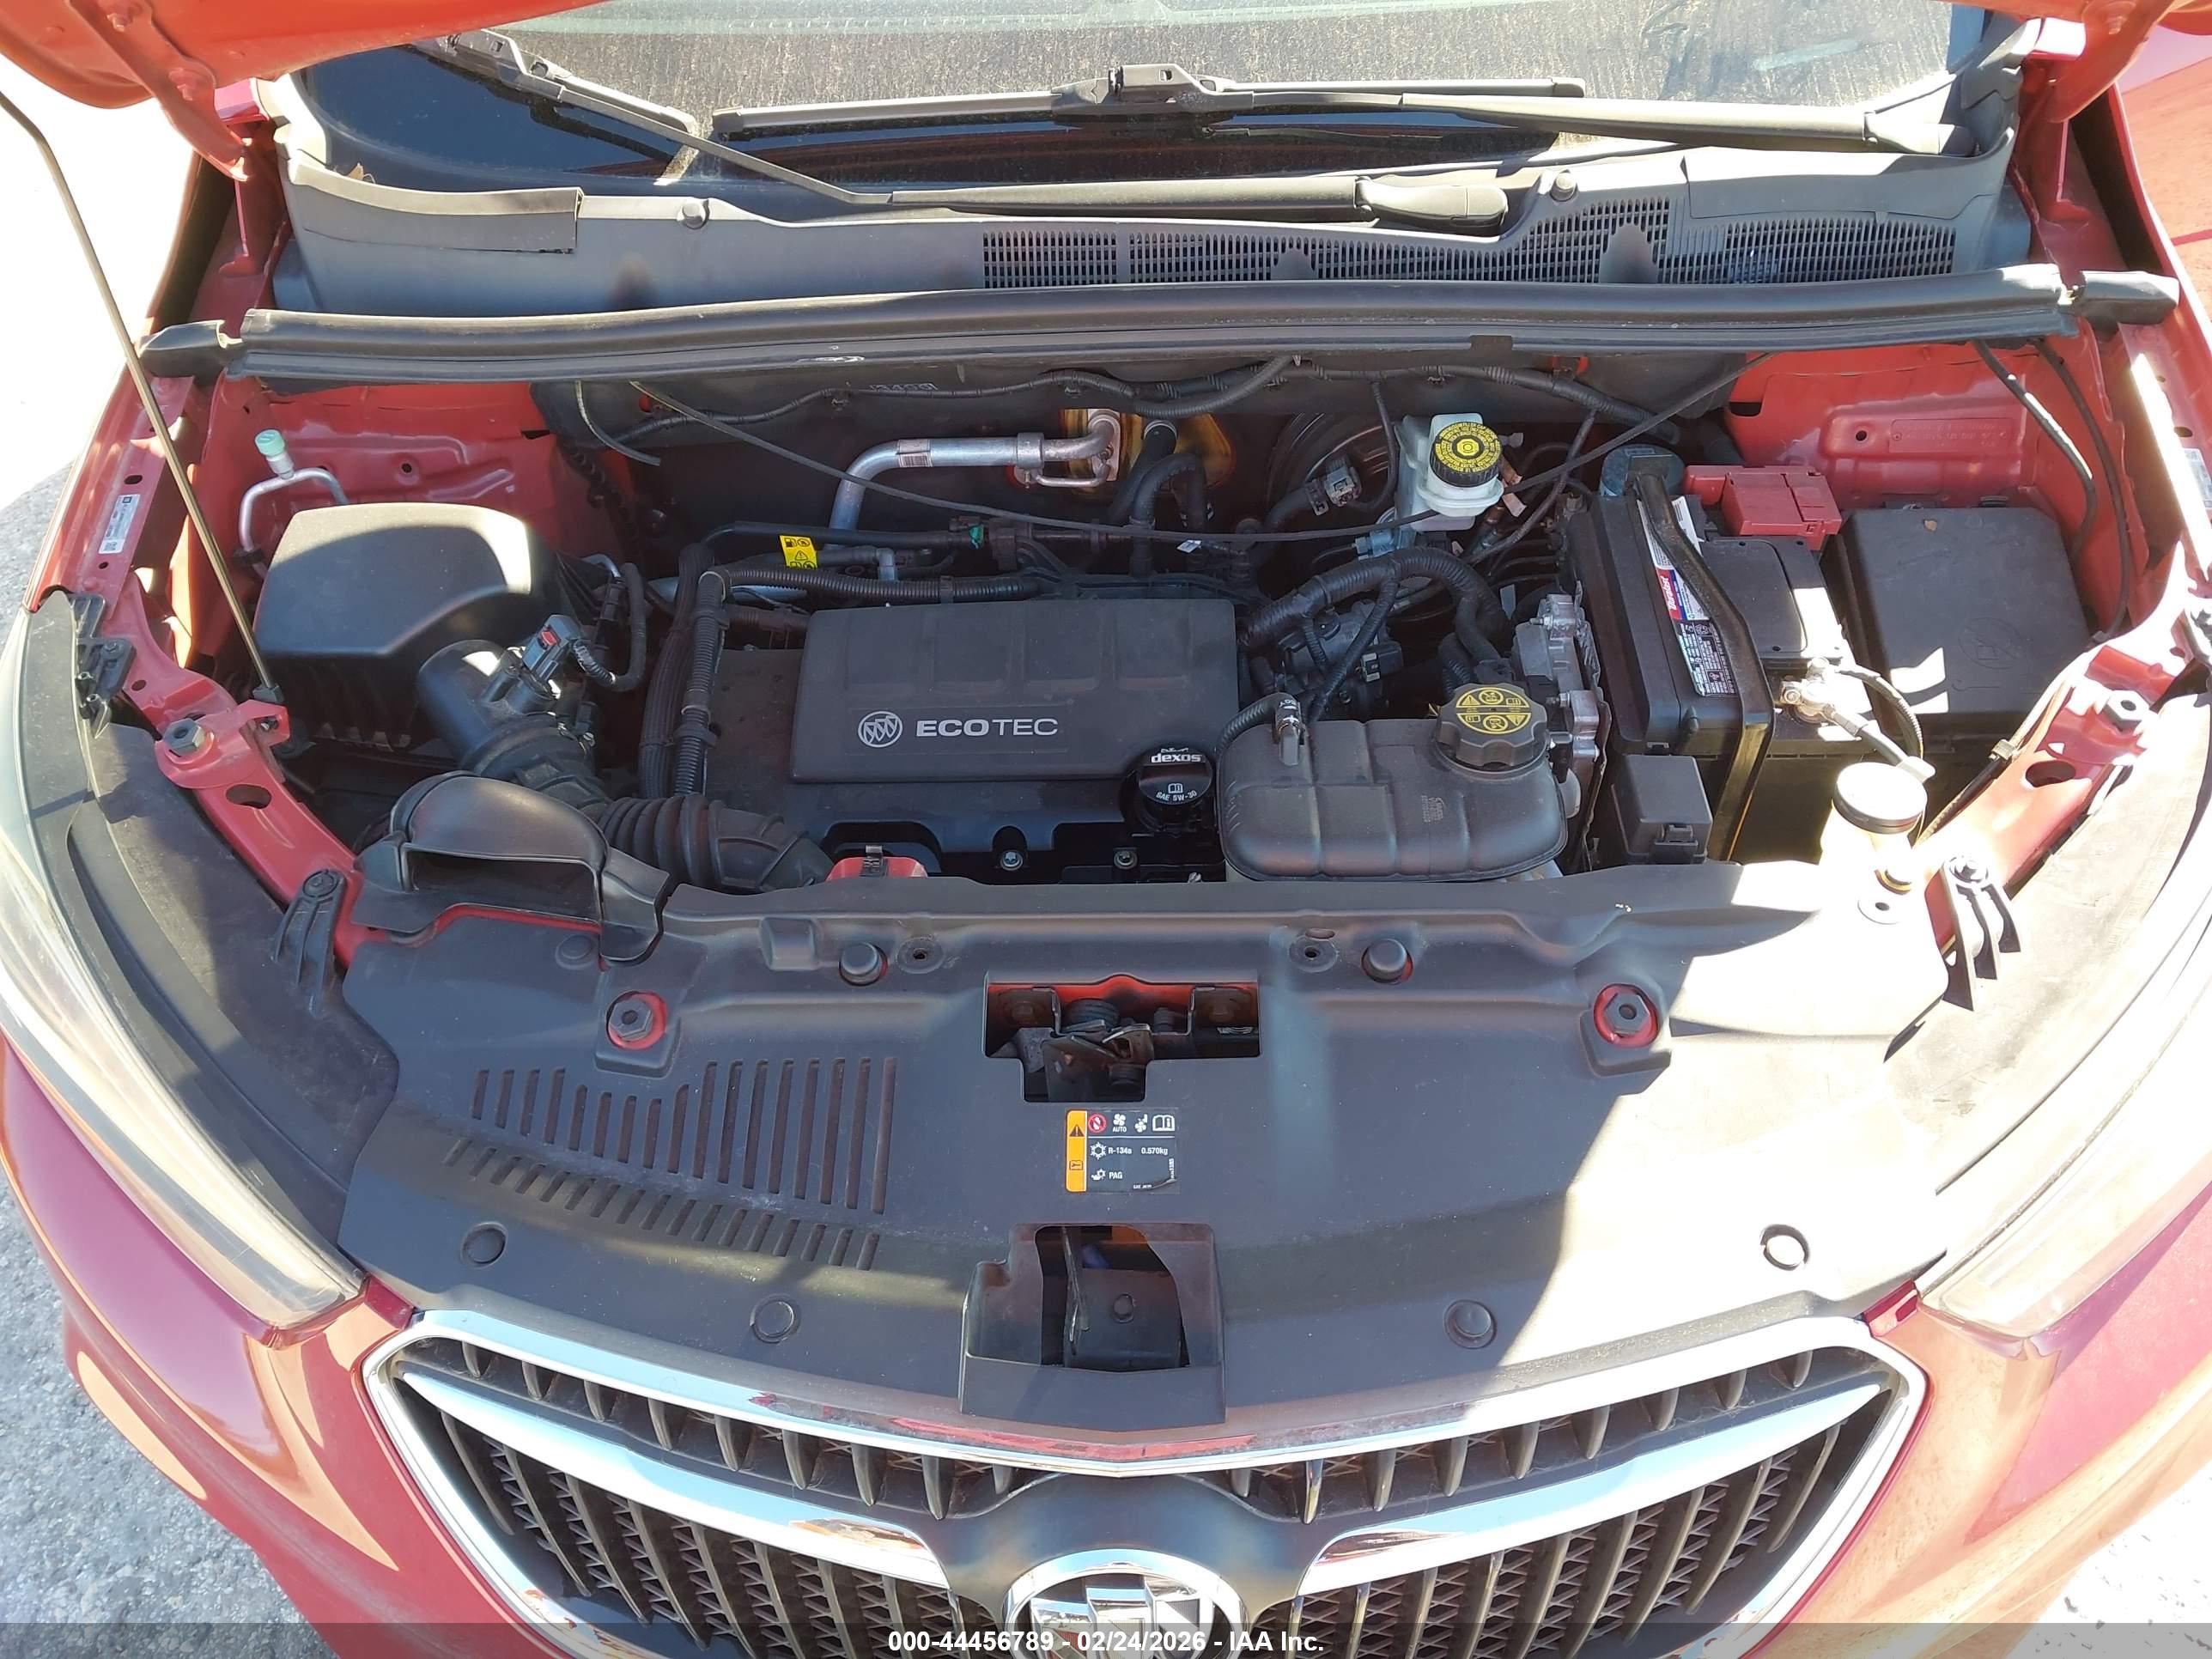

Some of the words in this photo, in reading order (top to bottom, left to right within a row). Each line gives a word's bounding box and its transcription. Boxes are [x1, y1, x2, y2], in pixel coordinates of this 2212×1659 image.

[915, 718, 1058, 737] ECOTEC
[1151, 752, 1202, 763] dexos
[1156, 791, 1170, 801] SAE
[1172, 790, 1197, 801] 5W-30
[1140, 1146, 1169, 1156] 0.570kg
[1109, 1171, 1123, 1180] PAG
